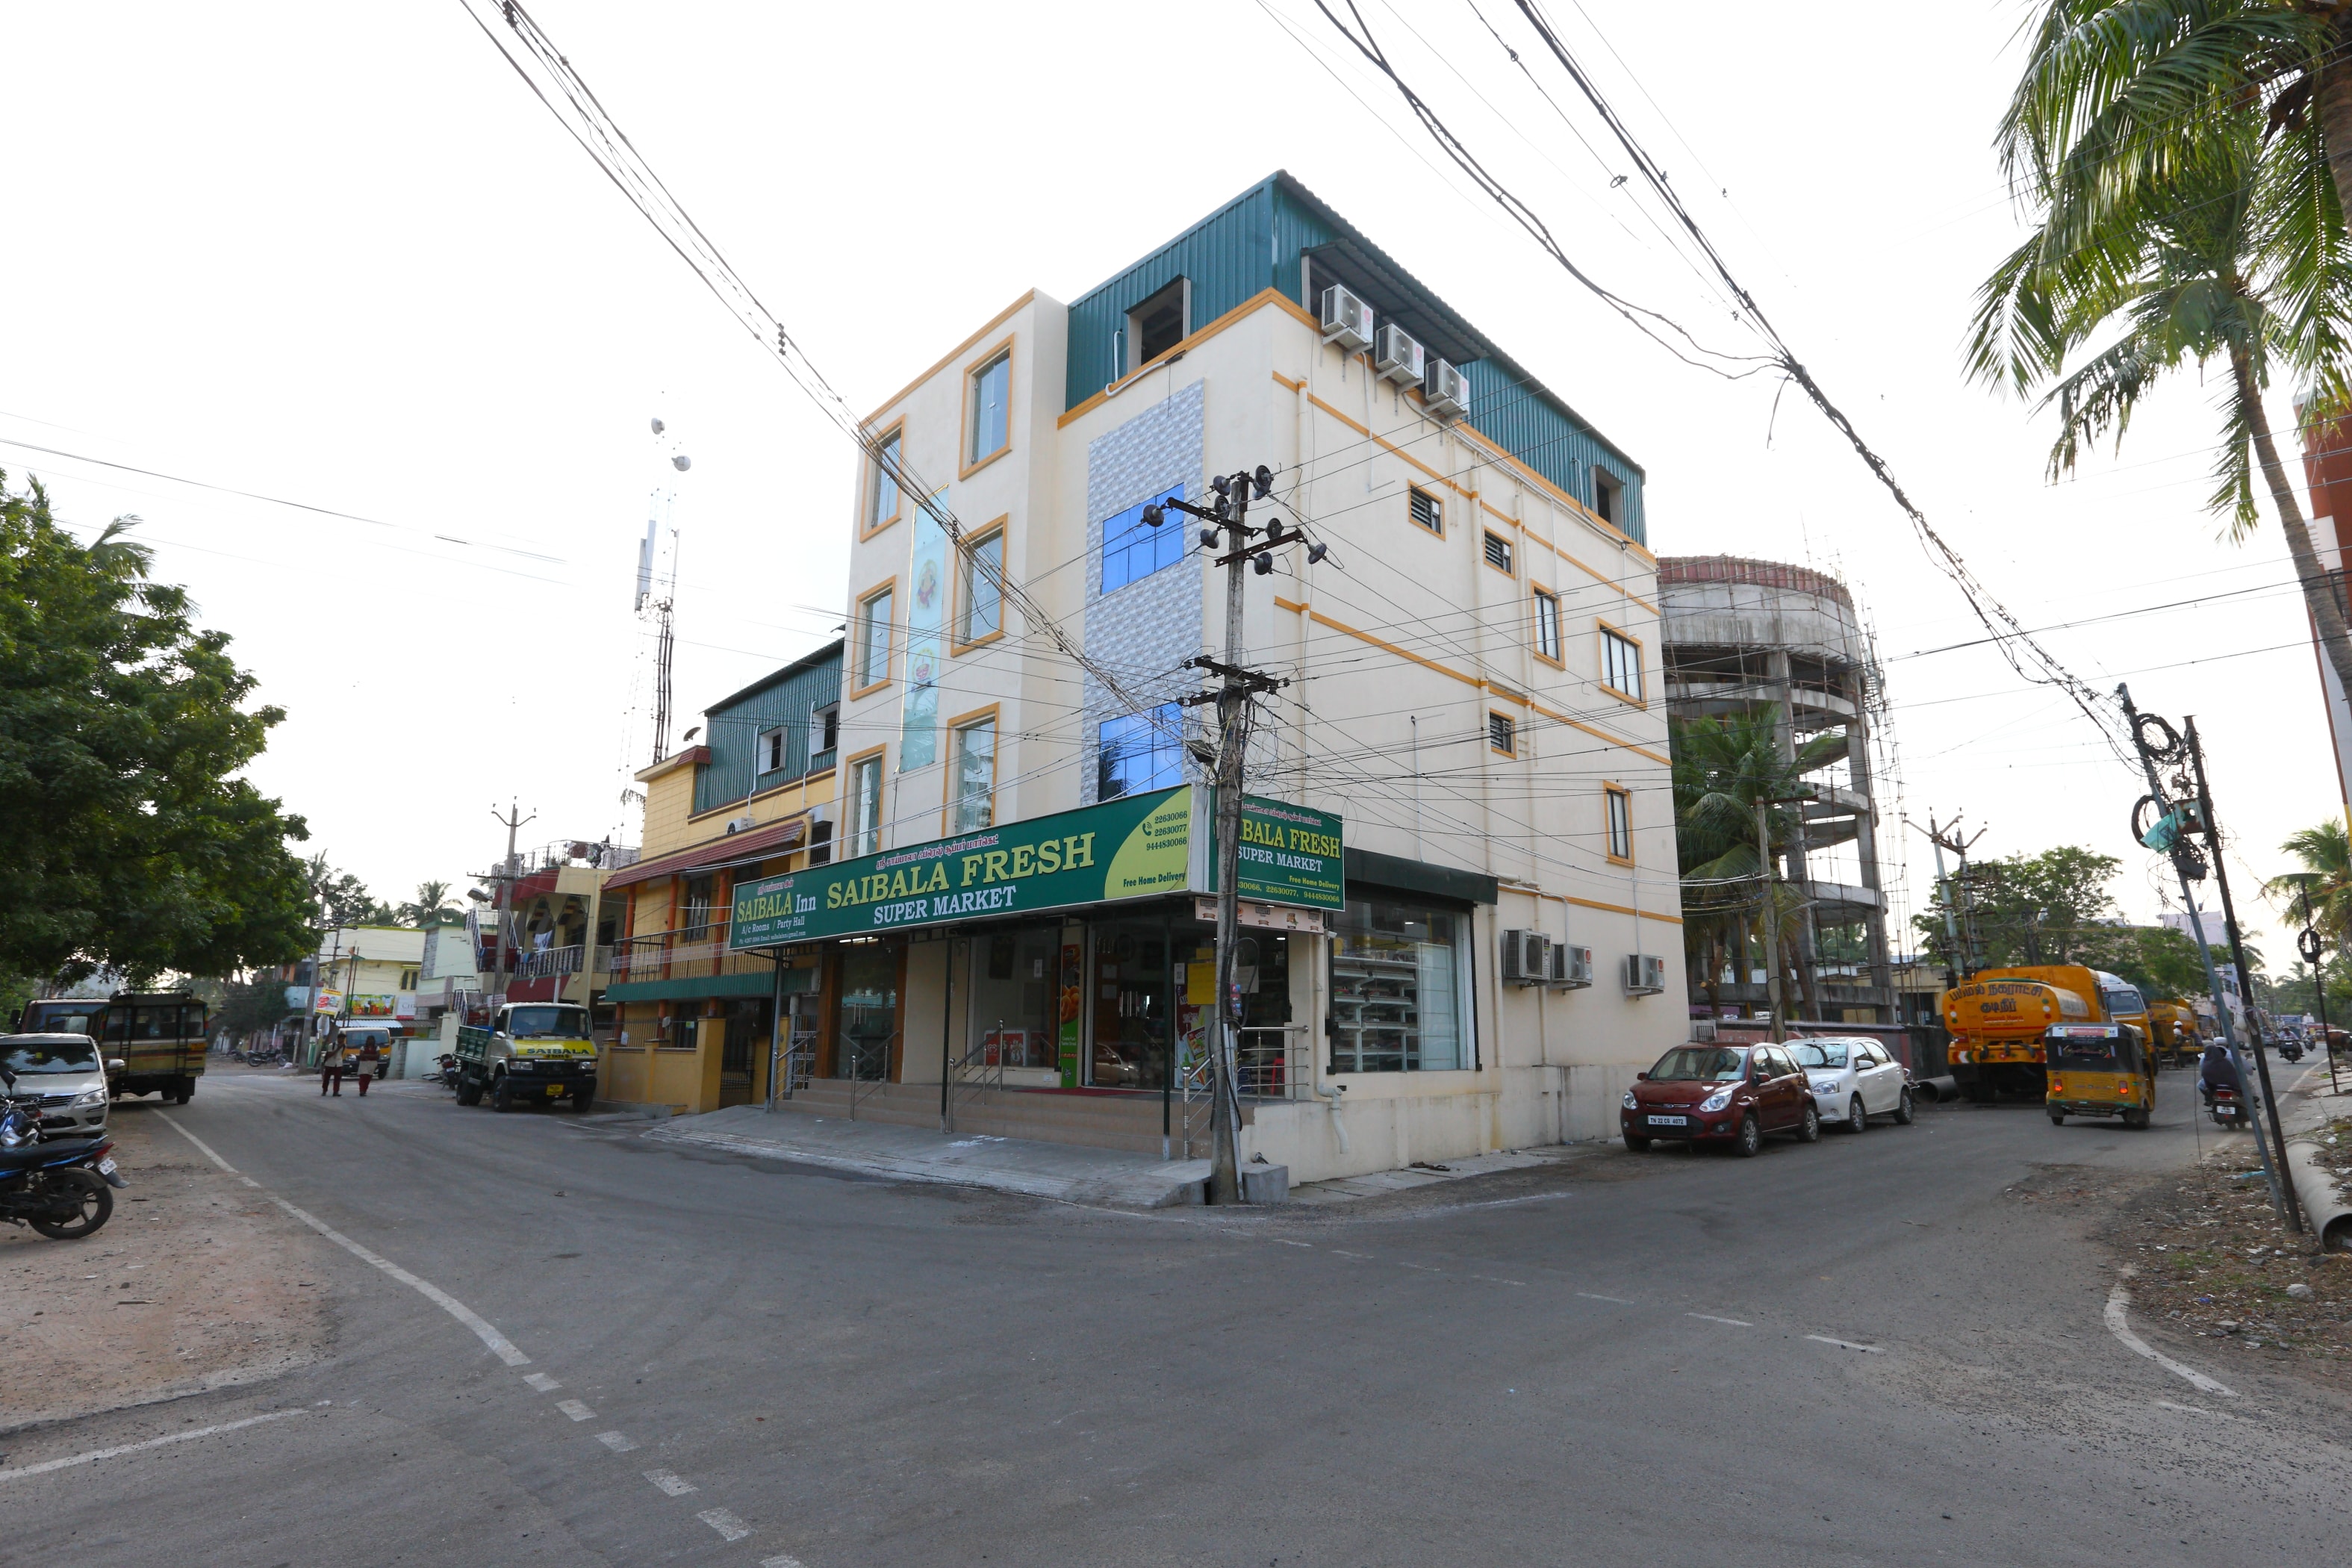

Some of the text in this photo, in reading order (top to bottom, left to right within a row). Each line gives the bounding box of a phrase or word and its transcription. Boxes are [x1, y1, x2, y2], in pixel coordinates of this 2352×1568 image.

[1154, 810, 1187, 824] 22630066
[1154, 824, 1187, 837] 22630077
[1239, 819, 1341, 859] BALA FRESH
[1146, 836, 1187, 851] 9444830066
[827, 832, 1095, 910] SAIBALA FRESH
[1276, 853, 1323, 873] MARKET
[1123, 871, 1186, 888] Free Home Delivery
[1289, 875, 1340, 892] Free Home Delivery
[737, 892, 816, 923] SAIBALA Inn
[874, 886, 1017, 925] SUPER MARKET
[741, 924, 751, 936] A/c
[752, 923, 770, 933] Rooms
[777, 918, 792, 930] Party
[793, 915, 805, 927] Hall
[1988, 983, 2044, 998] நகராட்சி
[1980, 998, 2017, 1013] குடிநீர்
